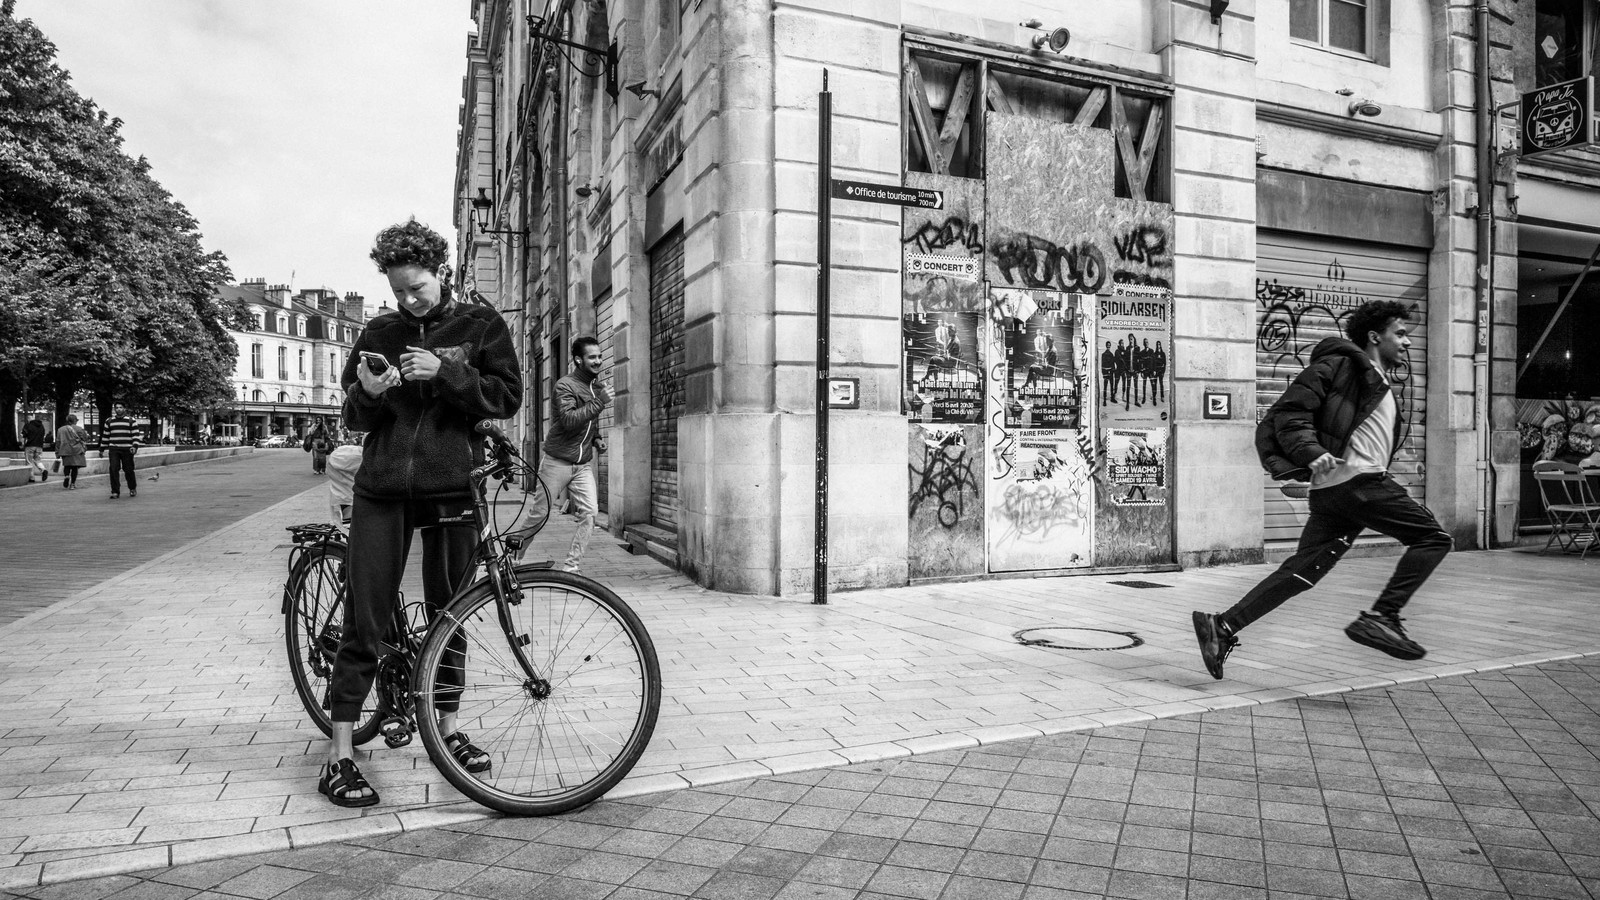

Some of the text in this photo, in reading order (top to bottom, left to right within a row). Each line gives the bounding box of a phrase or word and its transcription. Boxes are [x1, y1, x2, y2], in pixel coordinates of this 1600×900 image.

[1535, 84, 1575, 106] Papa Jo
[854, 187, 917, 202] Office de tourisme
[923, 261, 963, 272] CONCERT
[1125, 290, 1159, 298] CONCERT
[1316, 284, 1358, 294] MICHEL
[1100, 300, 1166, 323] SIDILARSEN
[1115, 465, 1157, 474] SIDI WACHO
